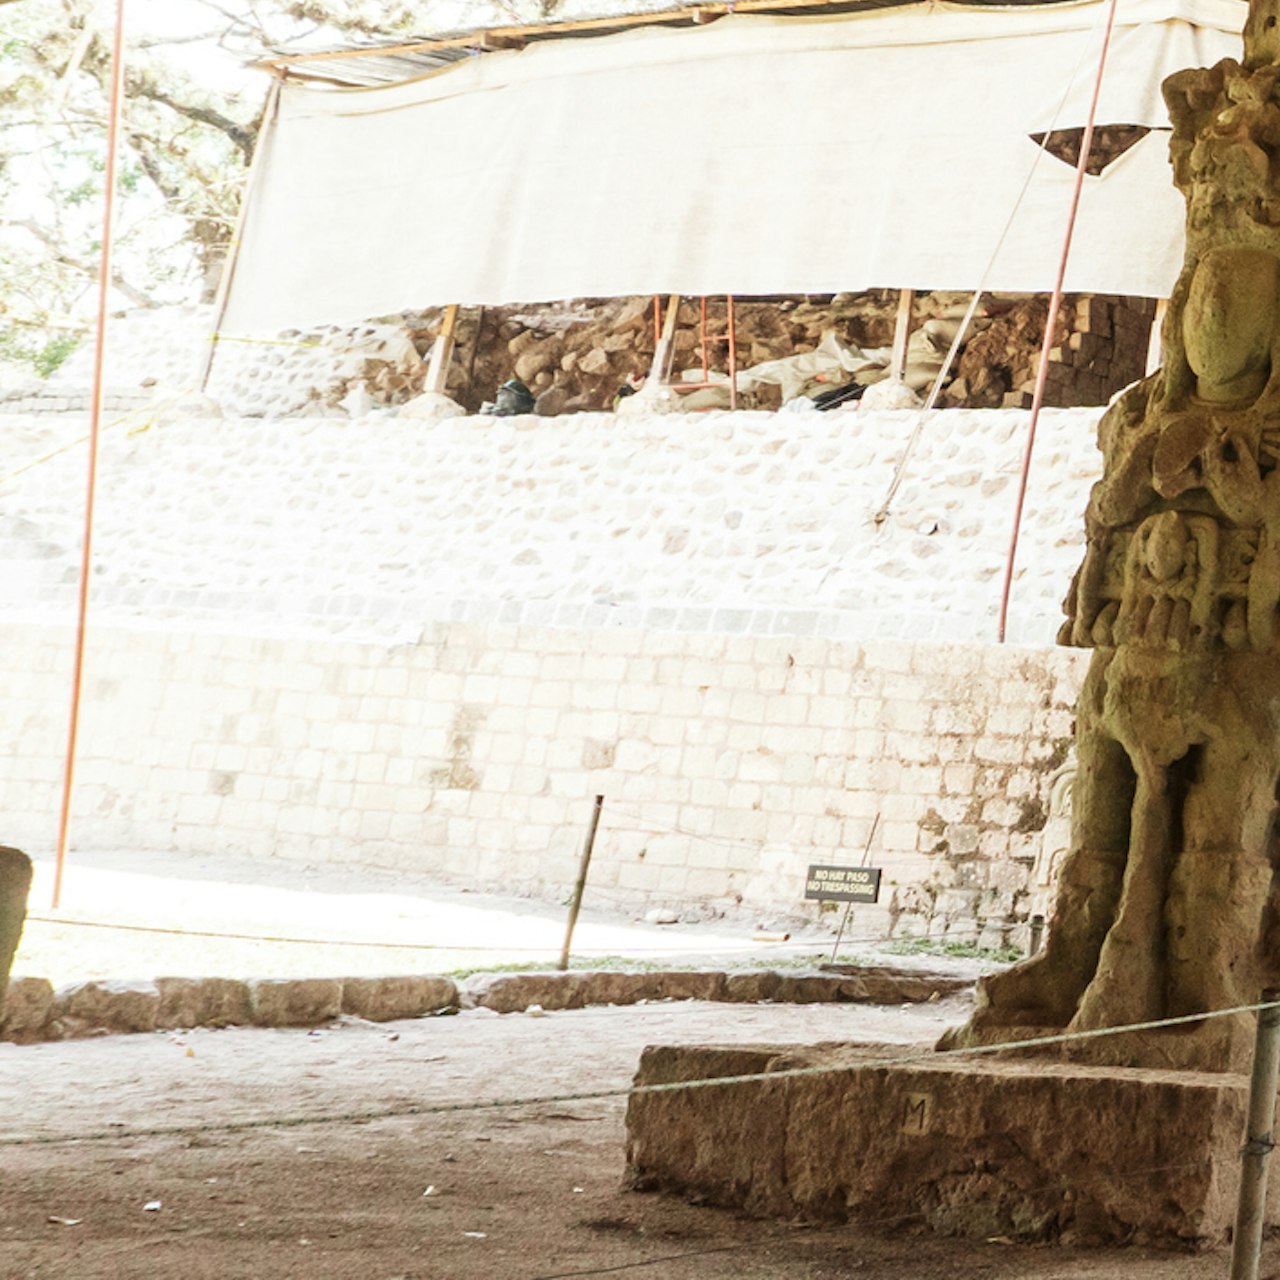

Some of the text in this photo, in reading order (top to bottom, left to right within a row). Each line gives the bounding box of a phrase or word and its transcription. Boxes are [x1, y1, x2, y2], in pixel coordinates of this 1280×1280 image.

[815, 870, 869, 882] NO HAY PASO
[807, 881, 874, 895] NO TRESPASSING
